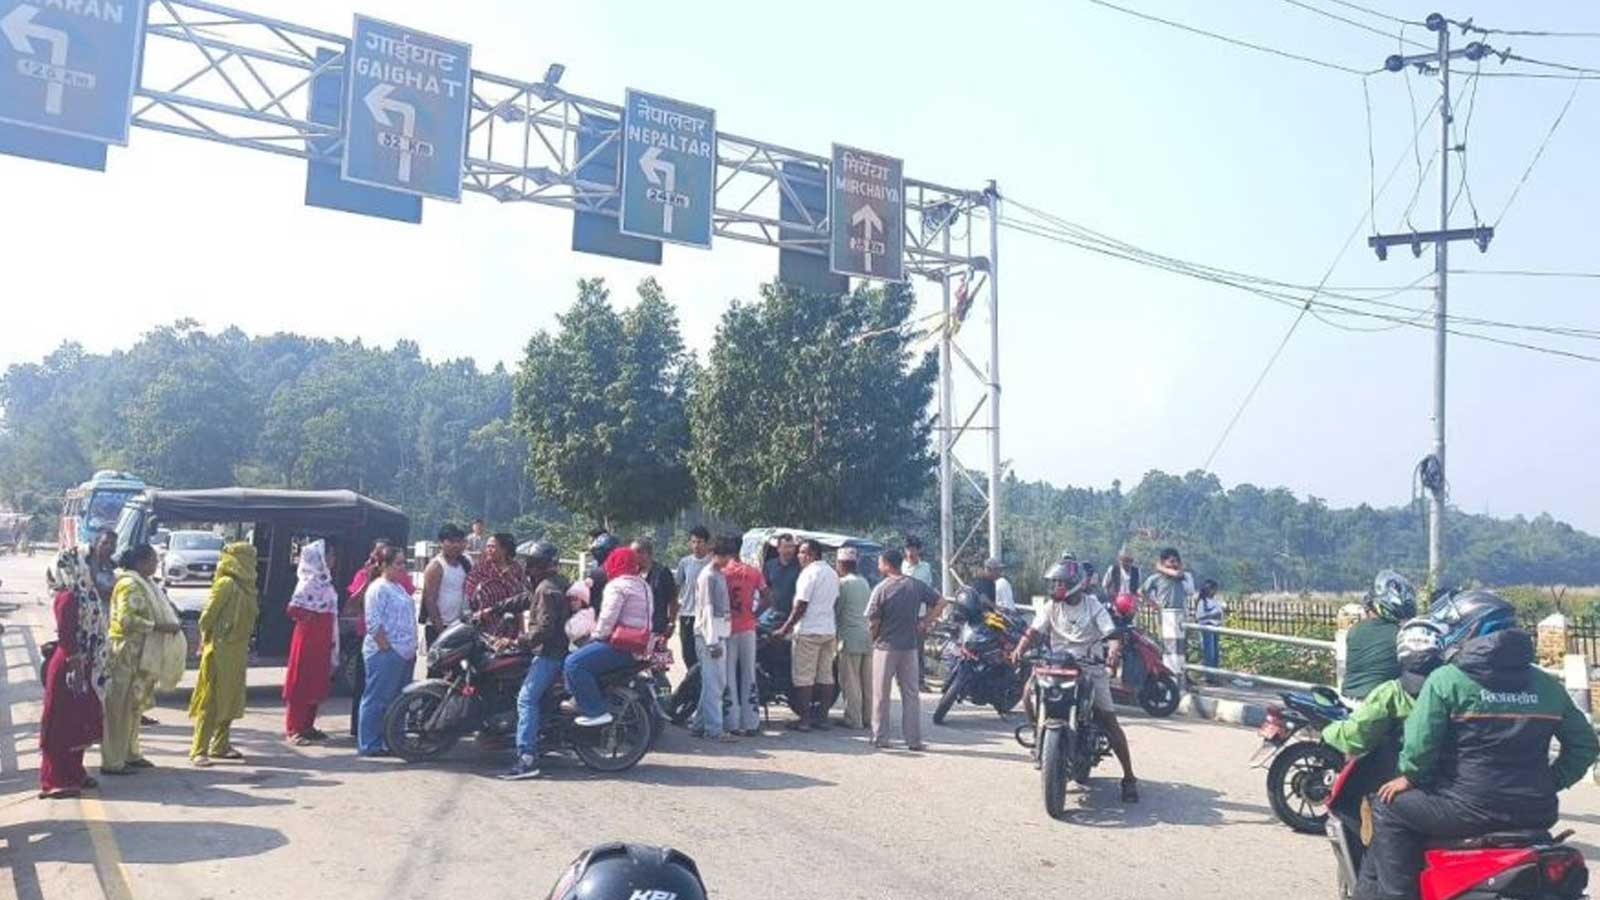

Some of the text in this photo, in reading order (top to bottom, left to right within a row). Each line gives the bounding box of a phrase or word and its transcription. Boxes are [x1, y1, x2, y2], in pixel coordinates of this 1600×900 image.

[365, 32, 458, 71] गाईघाट
[356, 57, 462, 97] GAIGHAT
[629, 125, 711, 158] NEPALTAR
